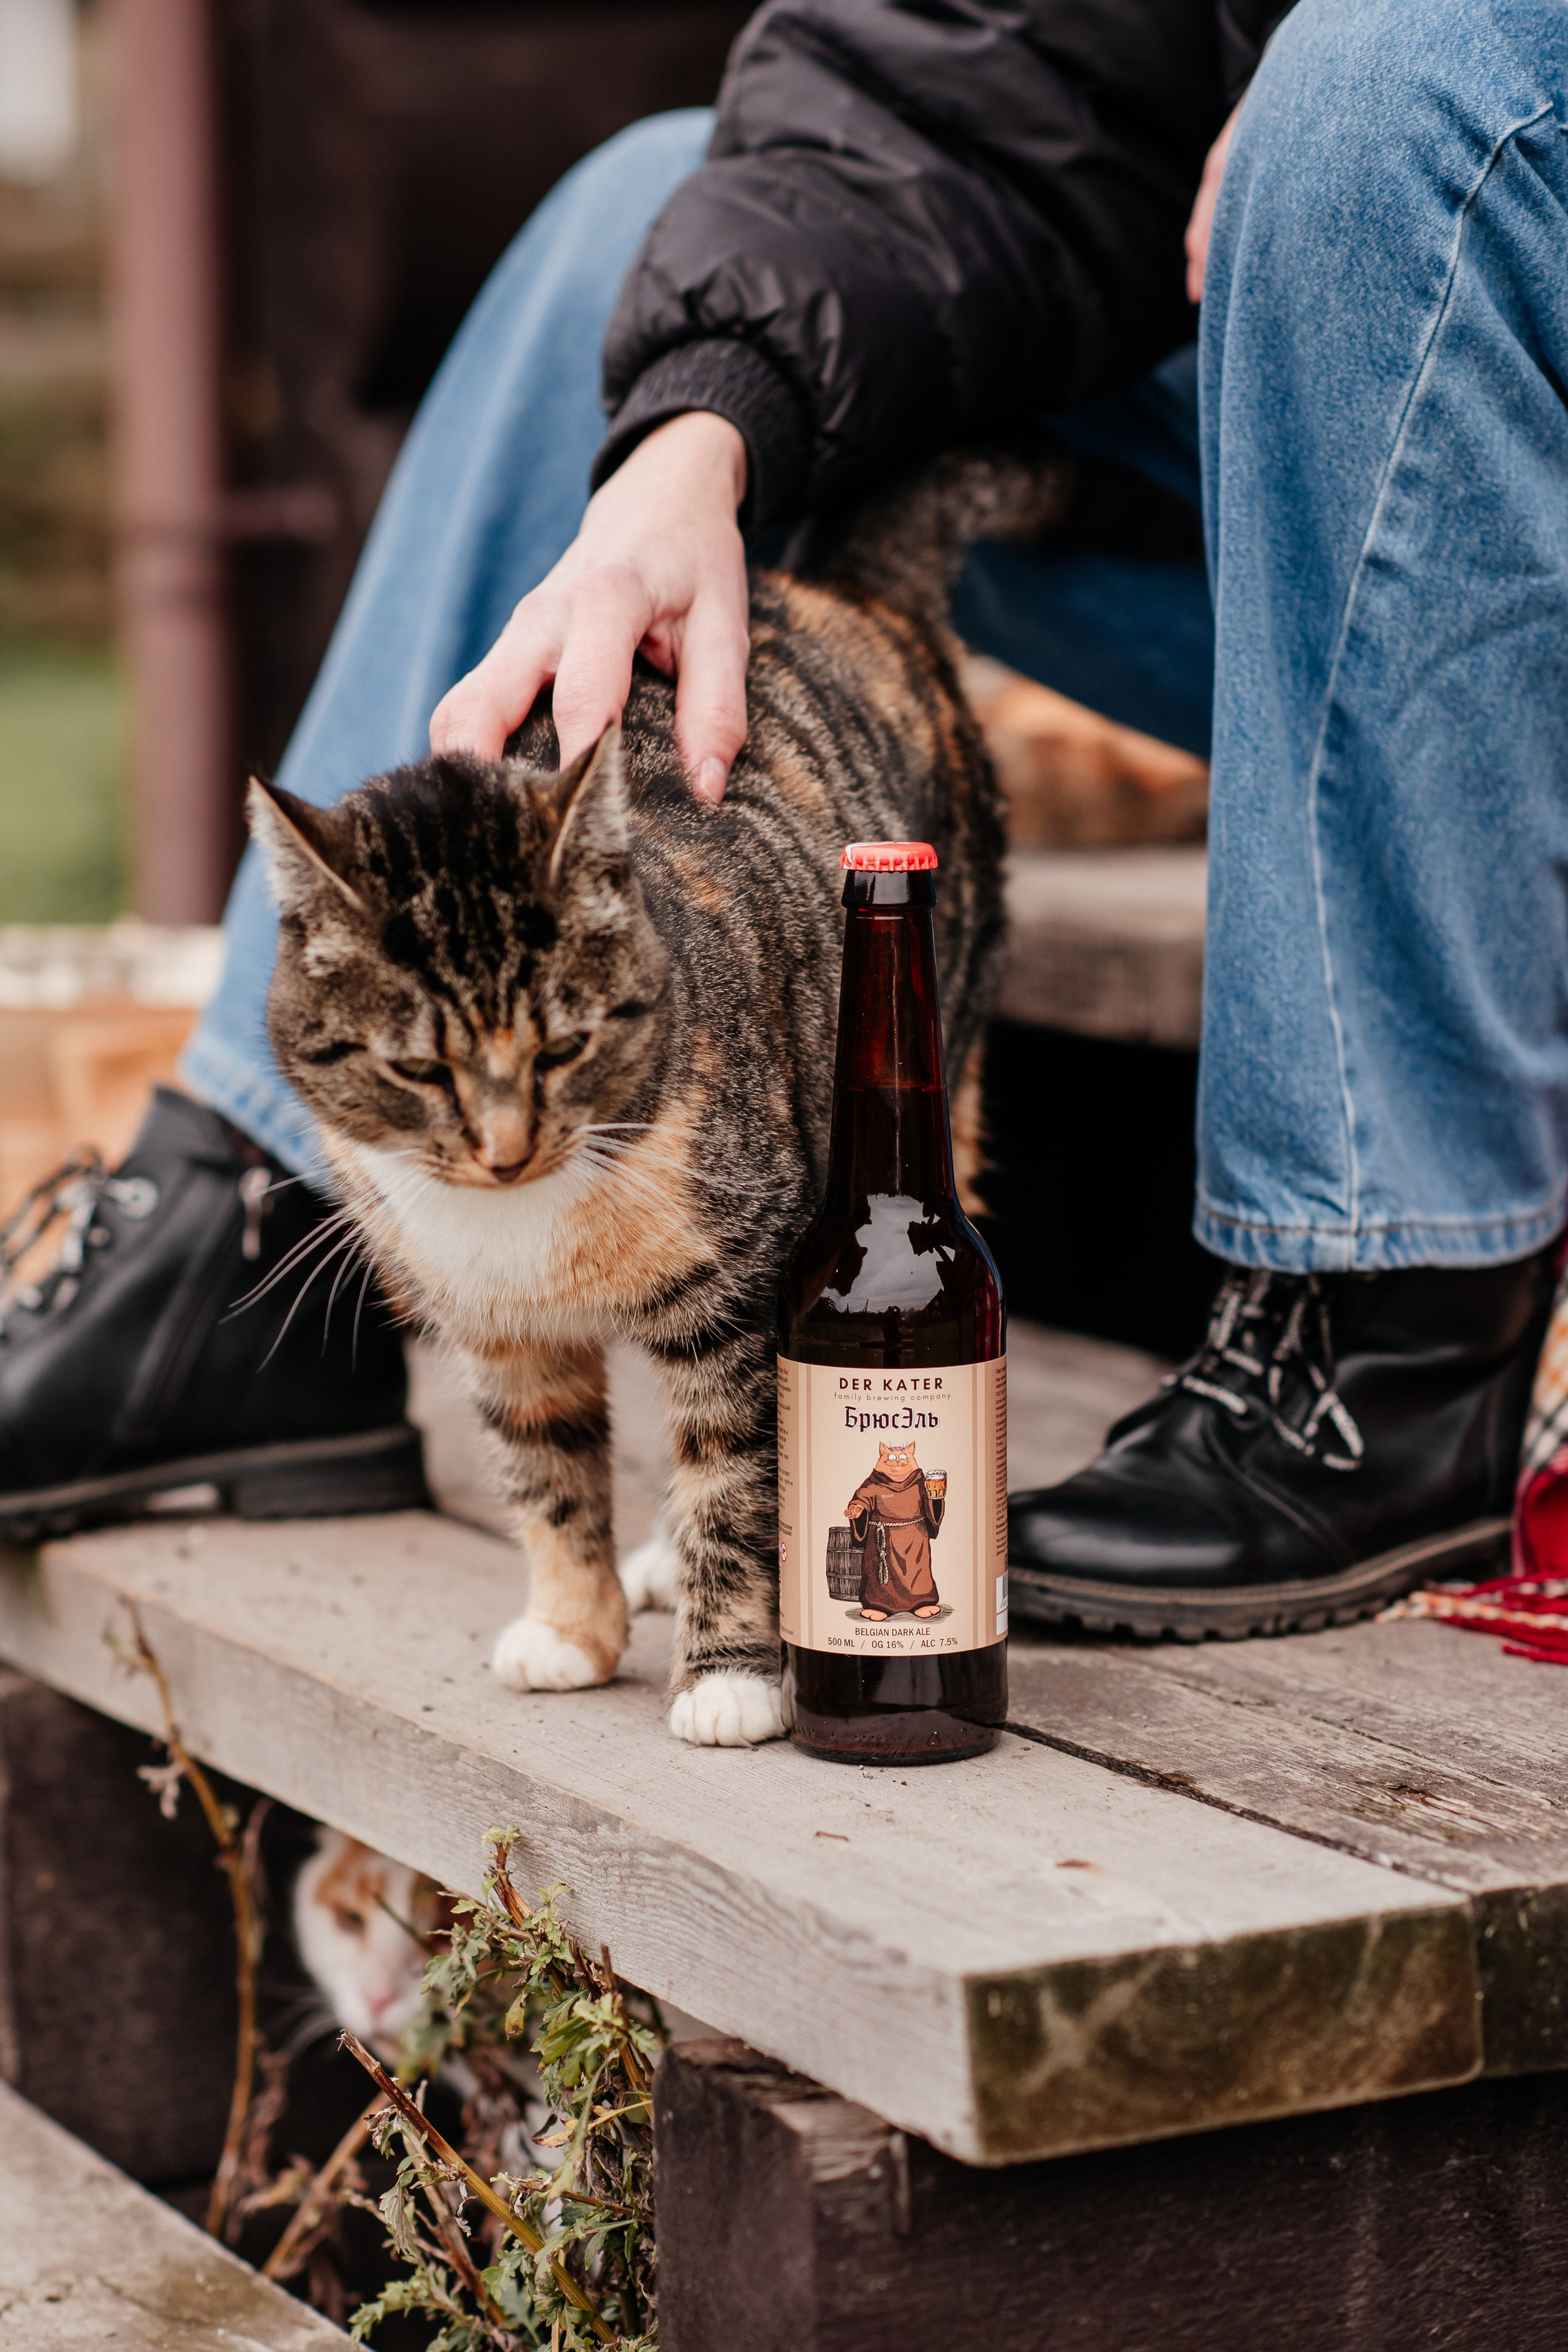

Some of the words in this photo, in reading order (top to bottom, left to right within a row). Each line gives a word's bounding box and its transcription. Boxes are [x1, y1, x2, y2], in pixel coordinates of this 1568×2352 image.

[839, 1378, 872, 1391] DER
[883, 1378, 943, 1391] KATER
[834, 1392, 862, 1403] family
[866, 1393, 905, 1403] brewing
[910, 1393, 951, 1402] company
[844, 1406, 938, 1433] БрюсЭль
[855, 1627, 889, 1637] BELGIAN
[892, 1628, 914, 1637] DARK
[916, 1627, 930, 1636] ALE
[827, 1637, 842, 1646] 500
[843, 1638, 855, 1648] ML
[871, 1640, 884, 1649] OG
[886, 1640, 904, 1649] 16%
[921, 1639, 936, 1648] ALC
[940, 1637, 958, 1647] 7.5%
